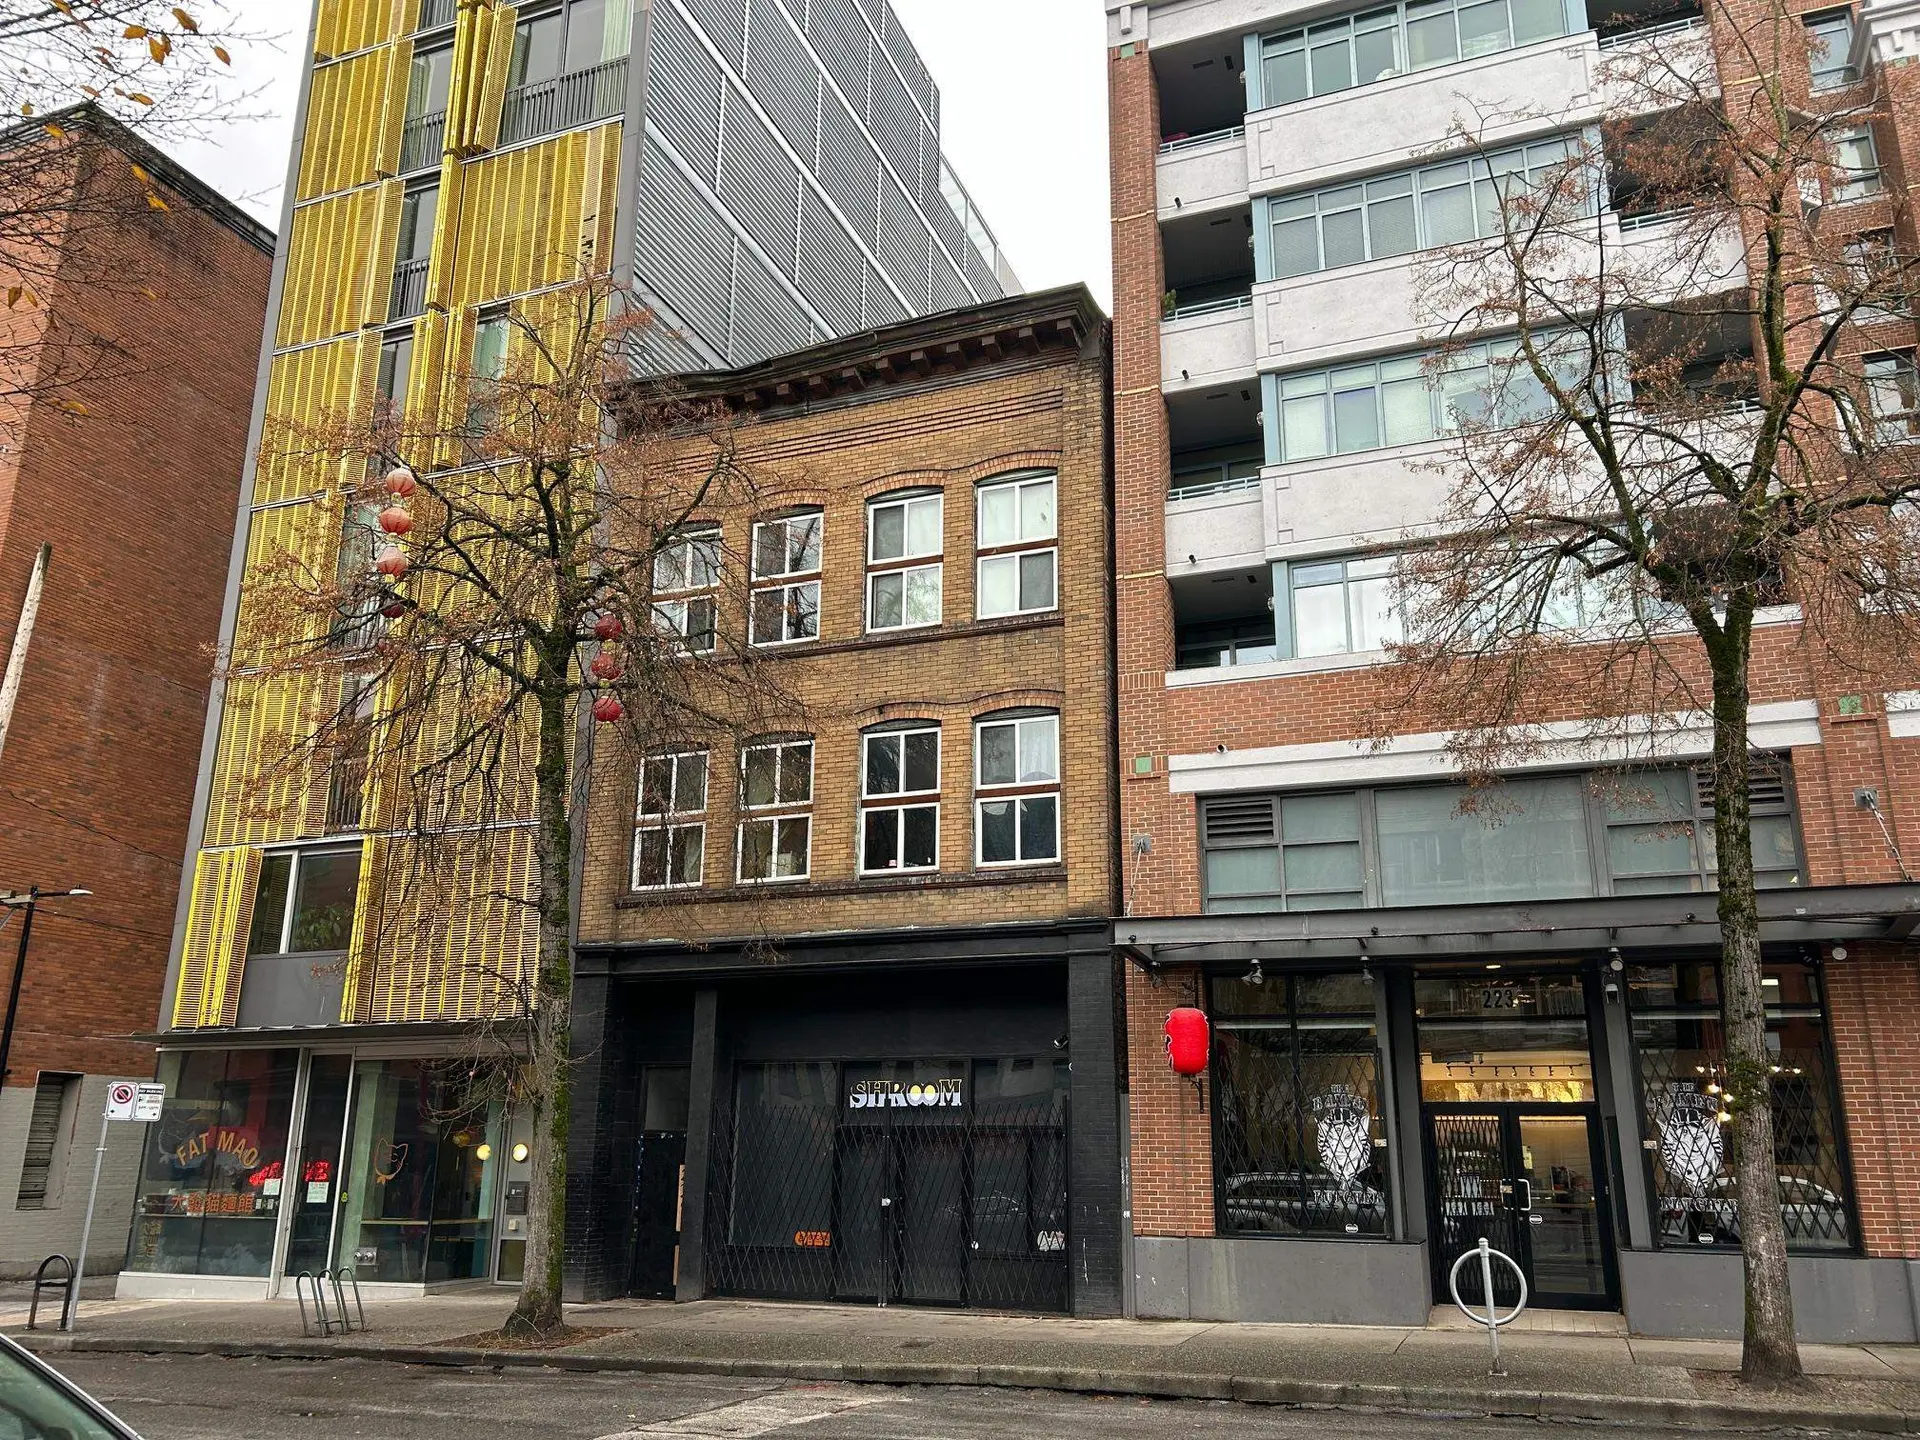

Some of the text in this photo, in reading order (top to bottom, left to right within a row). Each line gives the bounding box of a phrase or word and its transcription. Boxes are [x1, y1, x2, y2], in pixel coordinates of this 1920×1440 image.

[1483, 989, 1513, 1009] 223
[850, 1079, 962, 1108] SHROOM
[175, 1130, 260, 1168] FAT MAO
